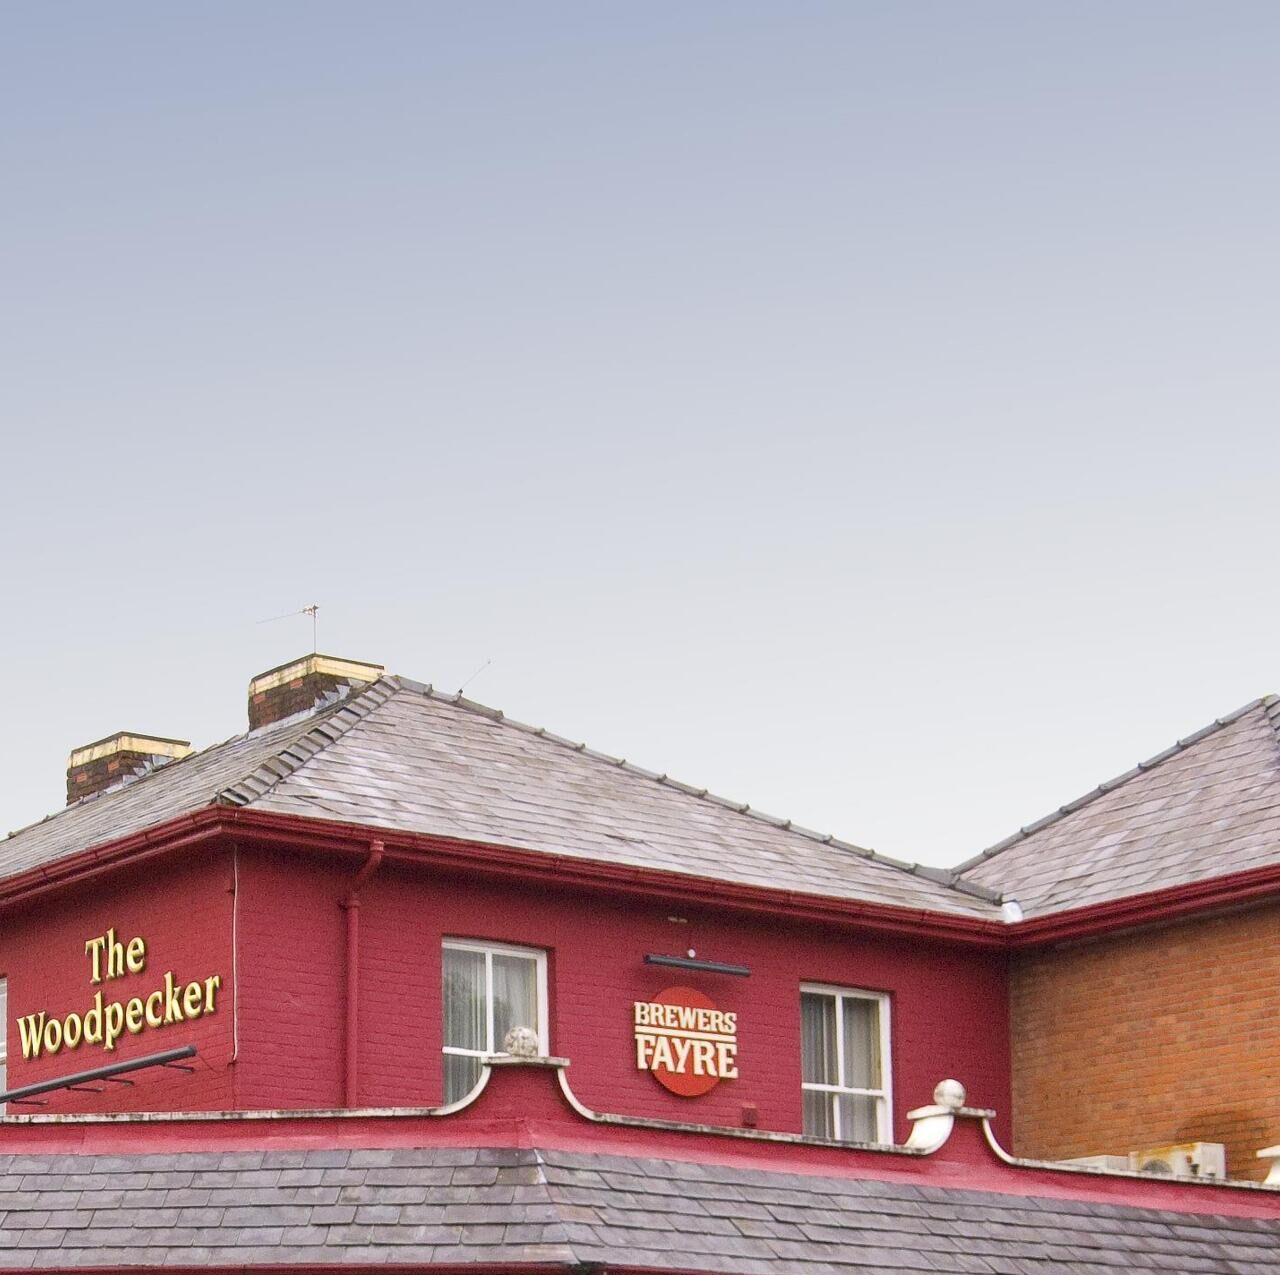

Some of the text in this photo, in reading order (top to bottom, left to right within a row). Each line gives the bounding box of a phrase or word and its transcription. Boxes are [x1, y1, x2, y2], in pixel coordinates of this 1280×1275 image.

[84, 927, 146, 985] The
[16, 971, 221, 1059] Woodpecker
[634, 1001, 738, 1034] BREWERS
[634, 1033, 739, 1079] FAYRE
